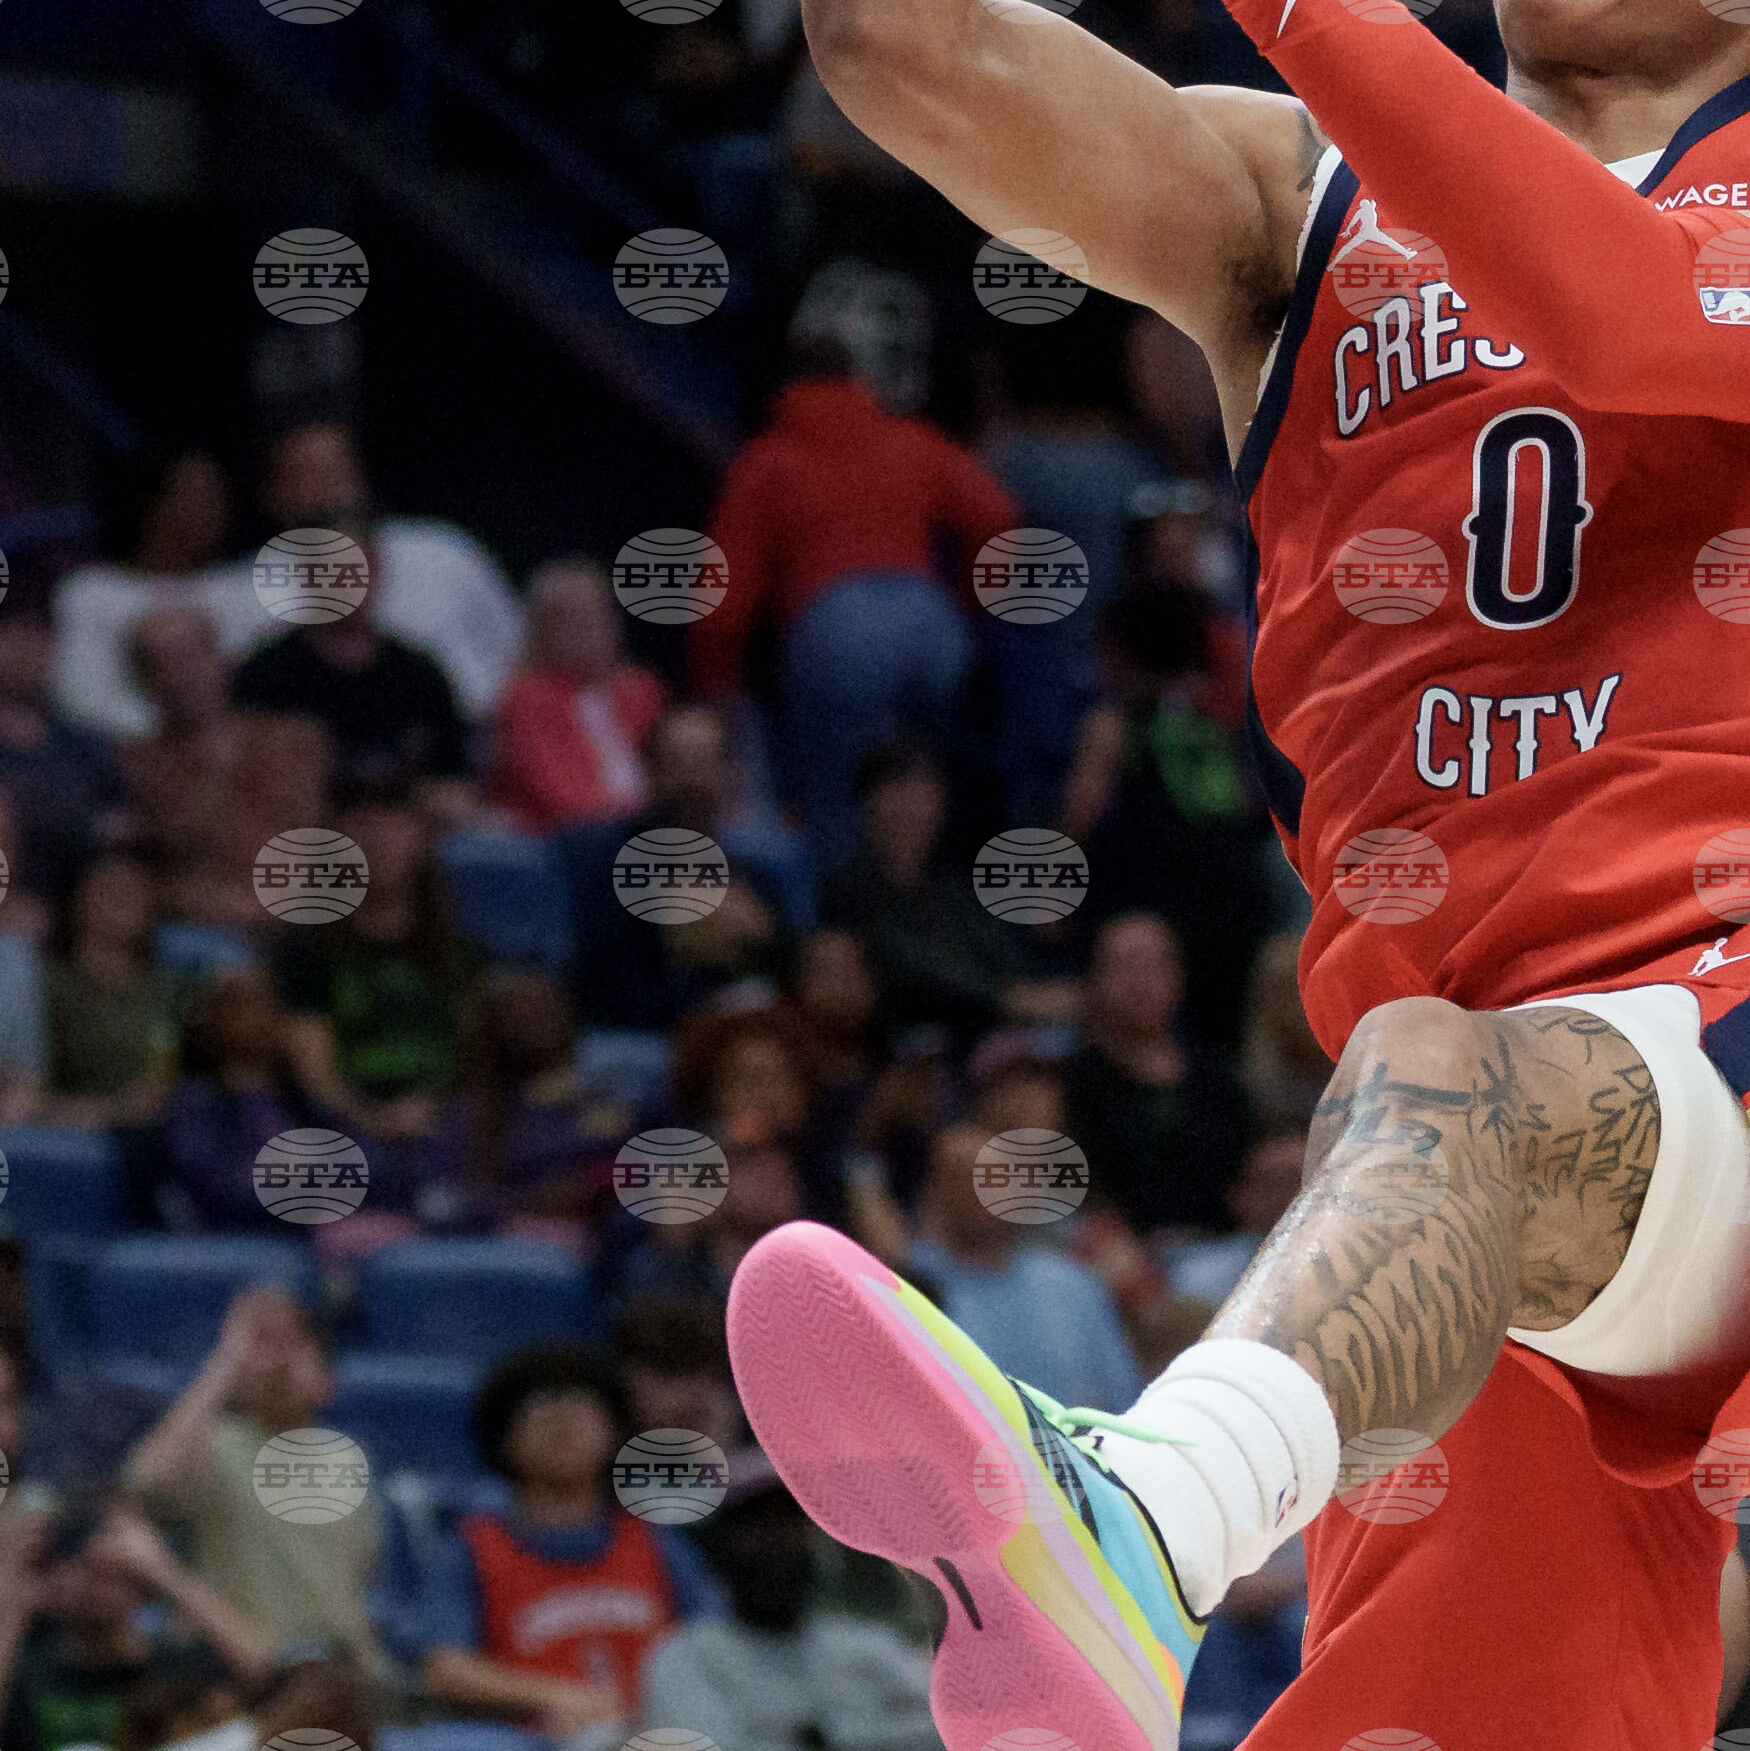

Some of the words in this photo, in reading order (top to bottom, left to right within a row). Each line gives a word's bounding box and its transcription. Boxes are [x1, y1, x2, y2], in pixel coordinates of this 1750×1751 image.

[1654, 182, 1749, 213] WAGE
[1461, 405, 1595, 631] 0
[1416, 672, 1624, 798] CITY
